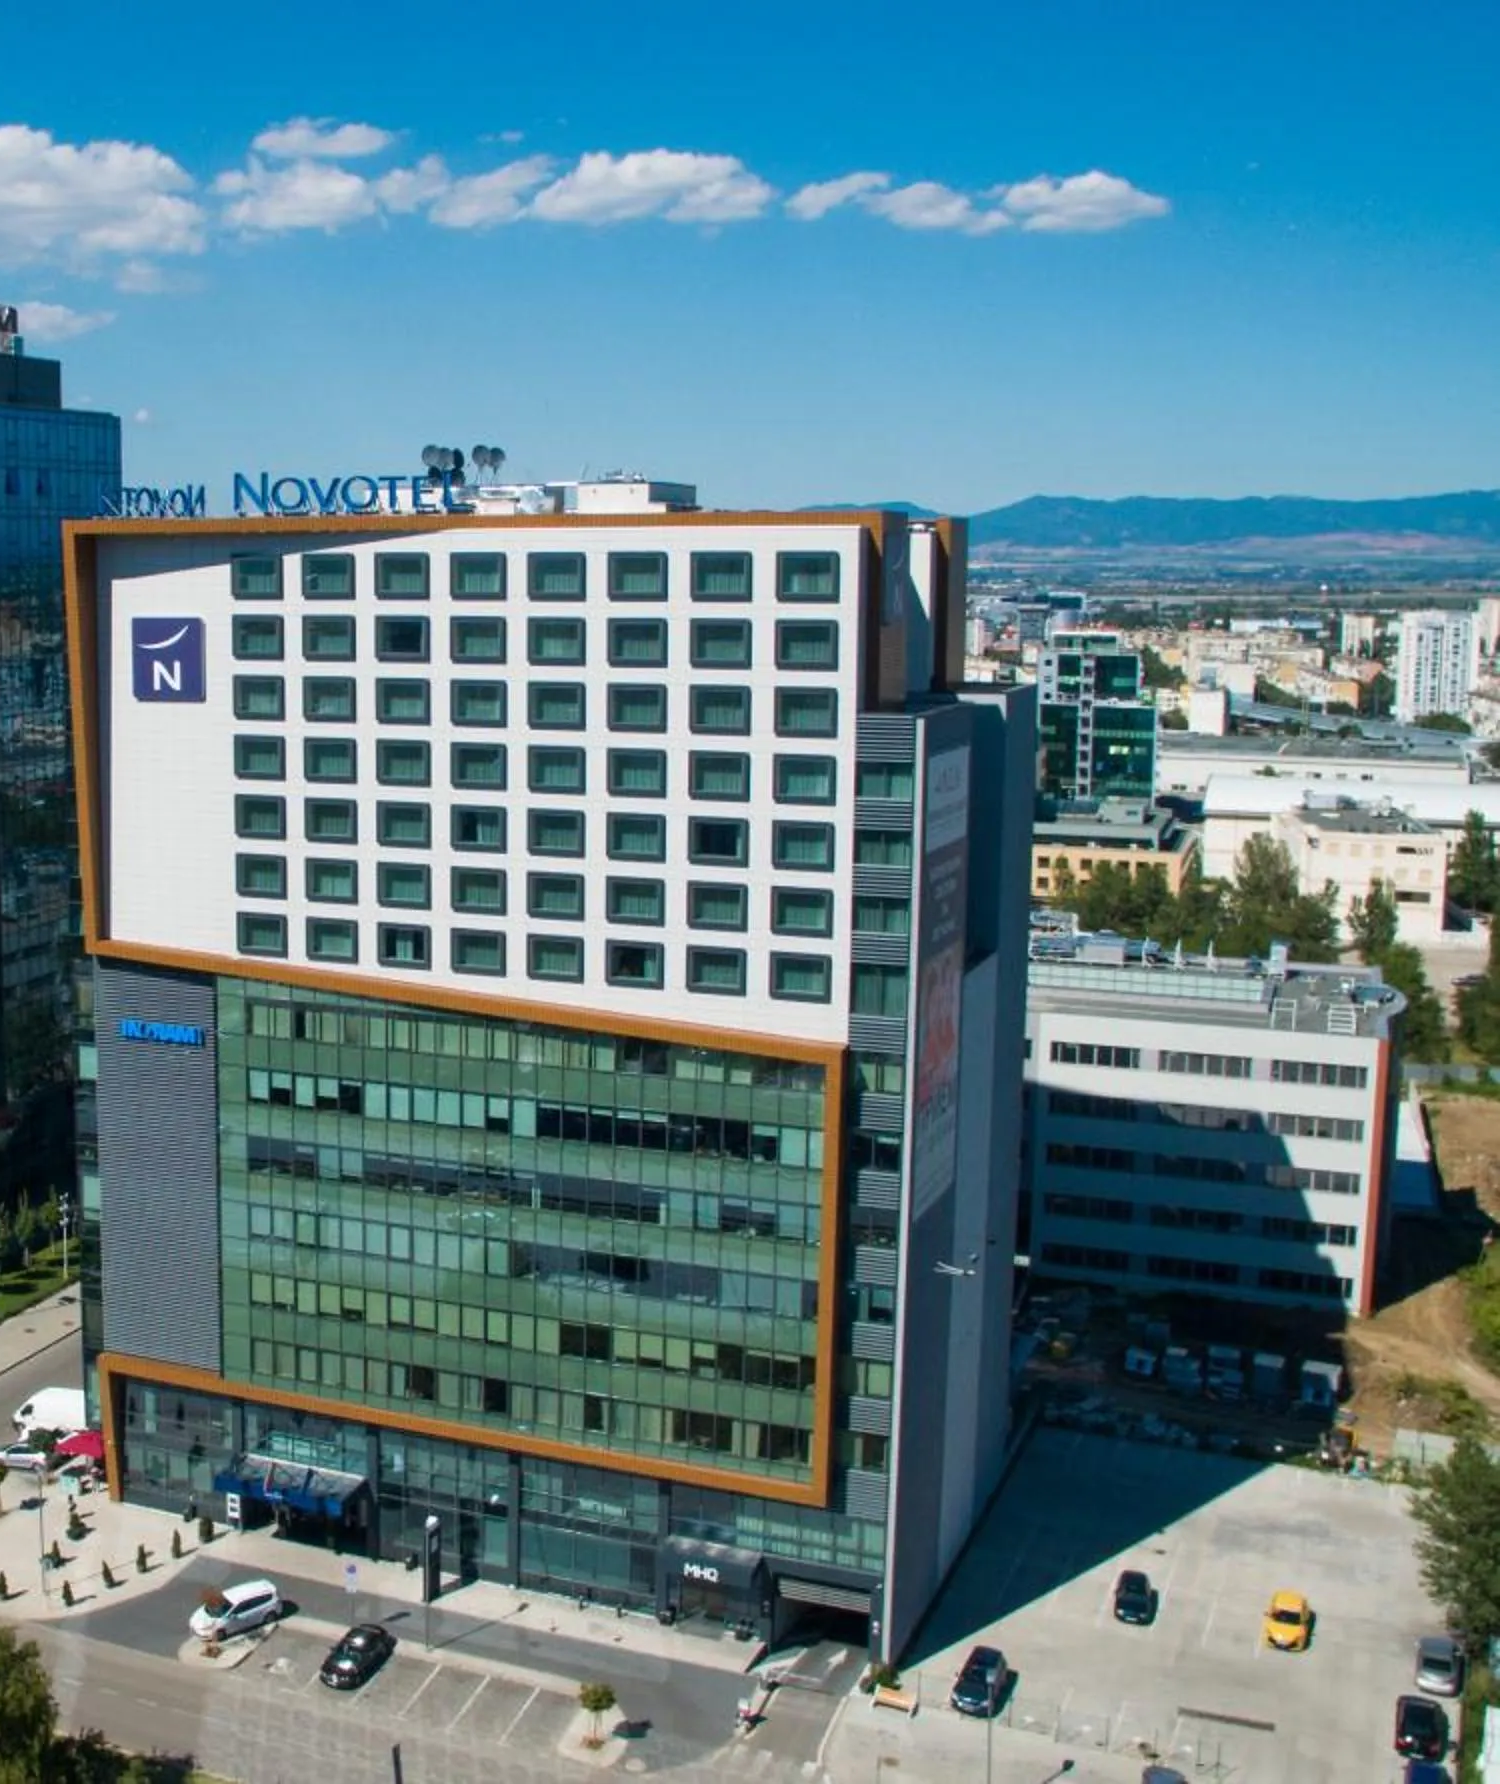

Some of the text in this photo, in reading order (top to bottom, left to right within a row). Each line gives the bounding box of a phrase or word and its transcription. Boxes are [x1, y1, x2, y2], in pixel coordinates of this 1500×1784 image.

[233, 470, 476, 514] NOVOTEL
[153, 660, 182, 691] N
[683, 1562, 719, 1583] MHQ
